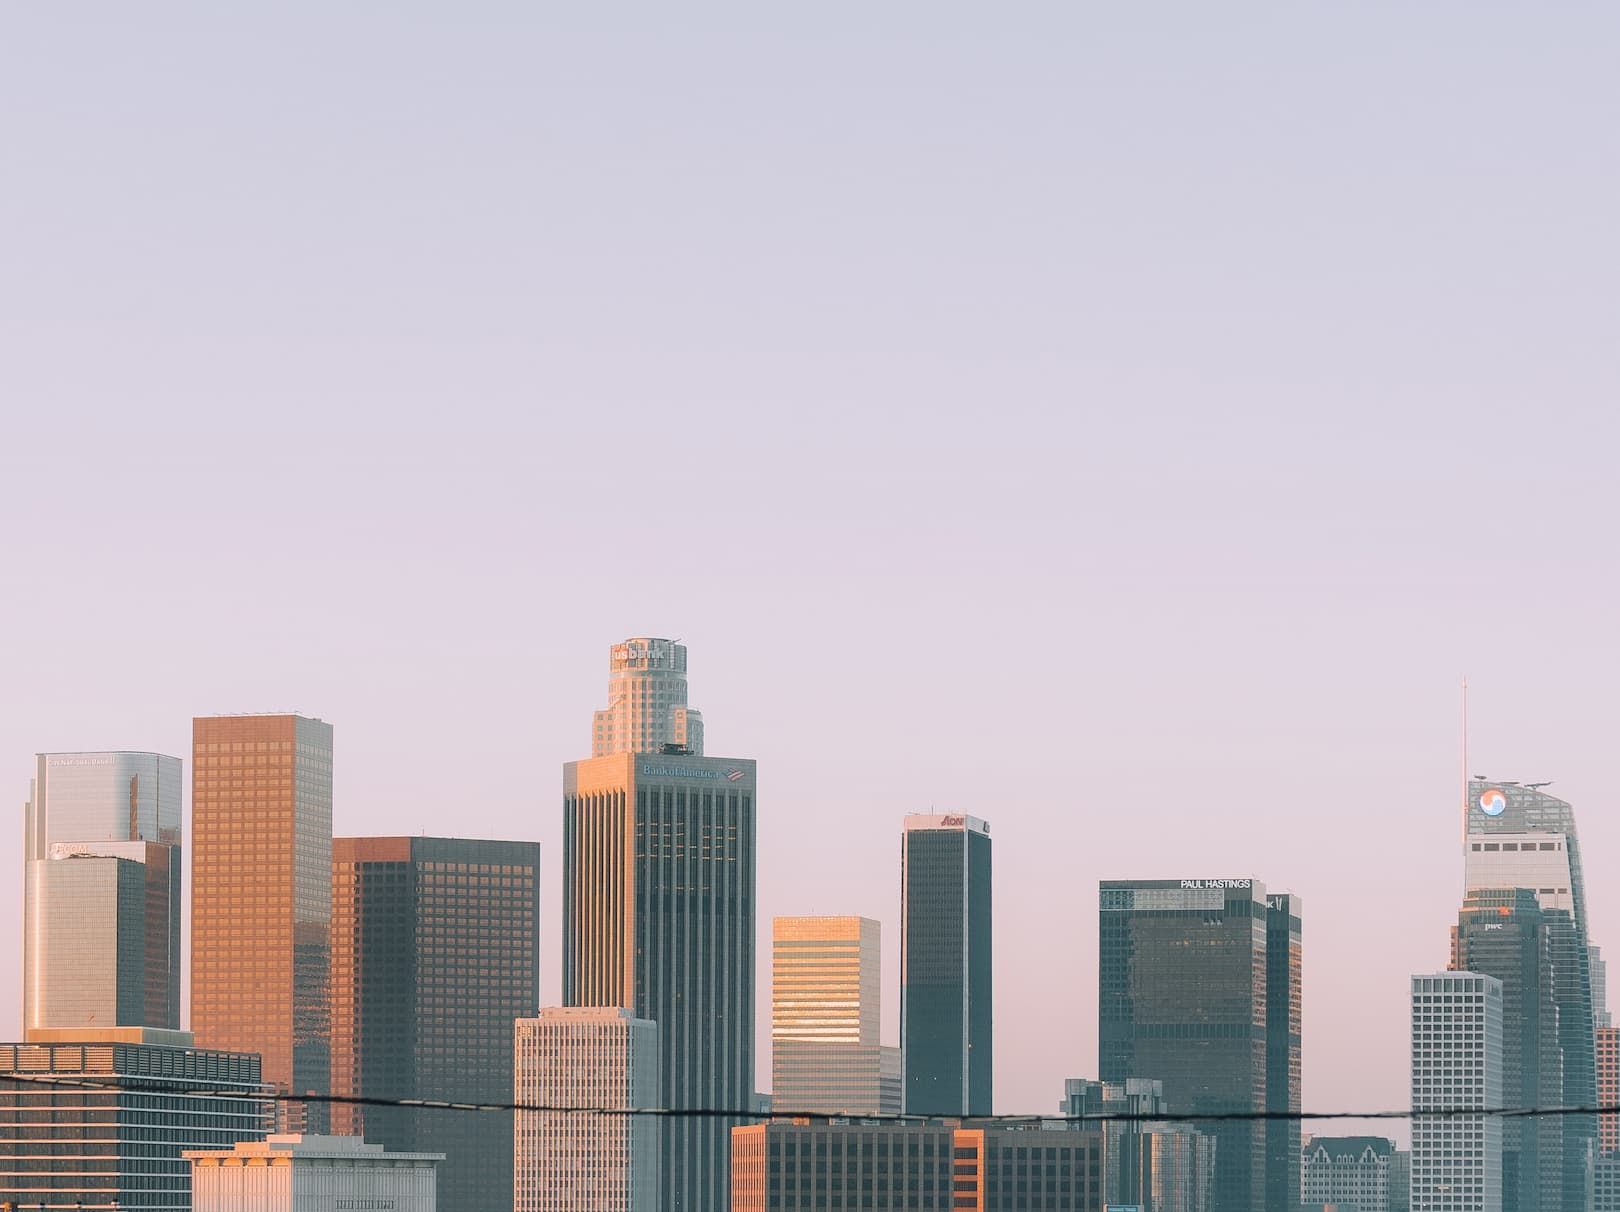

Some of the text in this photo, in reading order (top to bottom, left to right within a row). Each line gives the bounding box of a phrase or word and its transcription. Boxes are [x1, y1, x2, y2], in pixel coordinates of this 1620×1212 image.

[1180, 879, 1251, 889] PAUL HASTINGS
[1485, 923, 1503, 931] pwc
